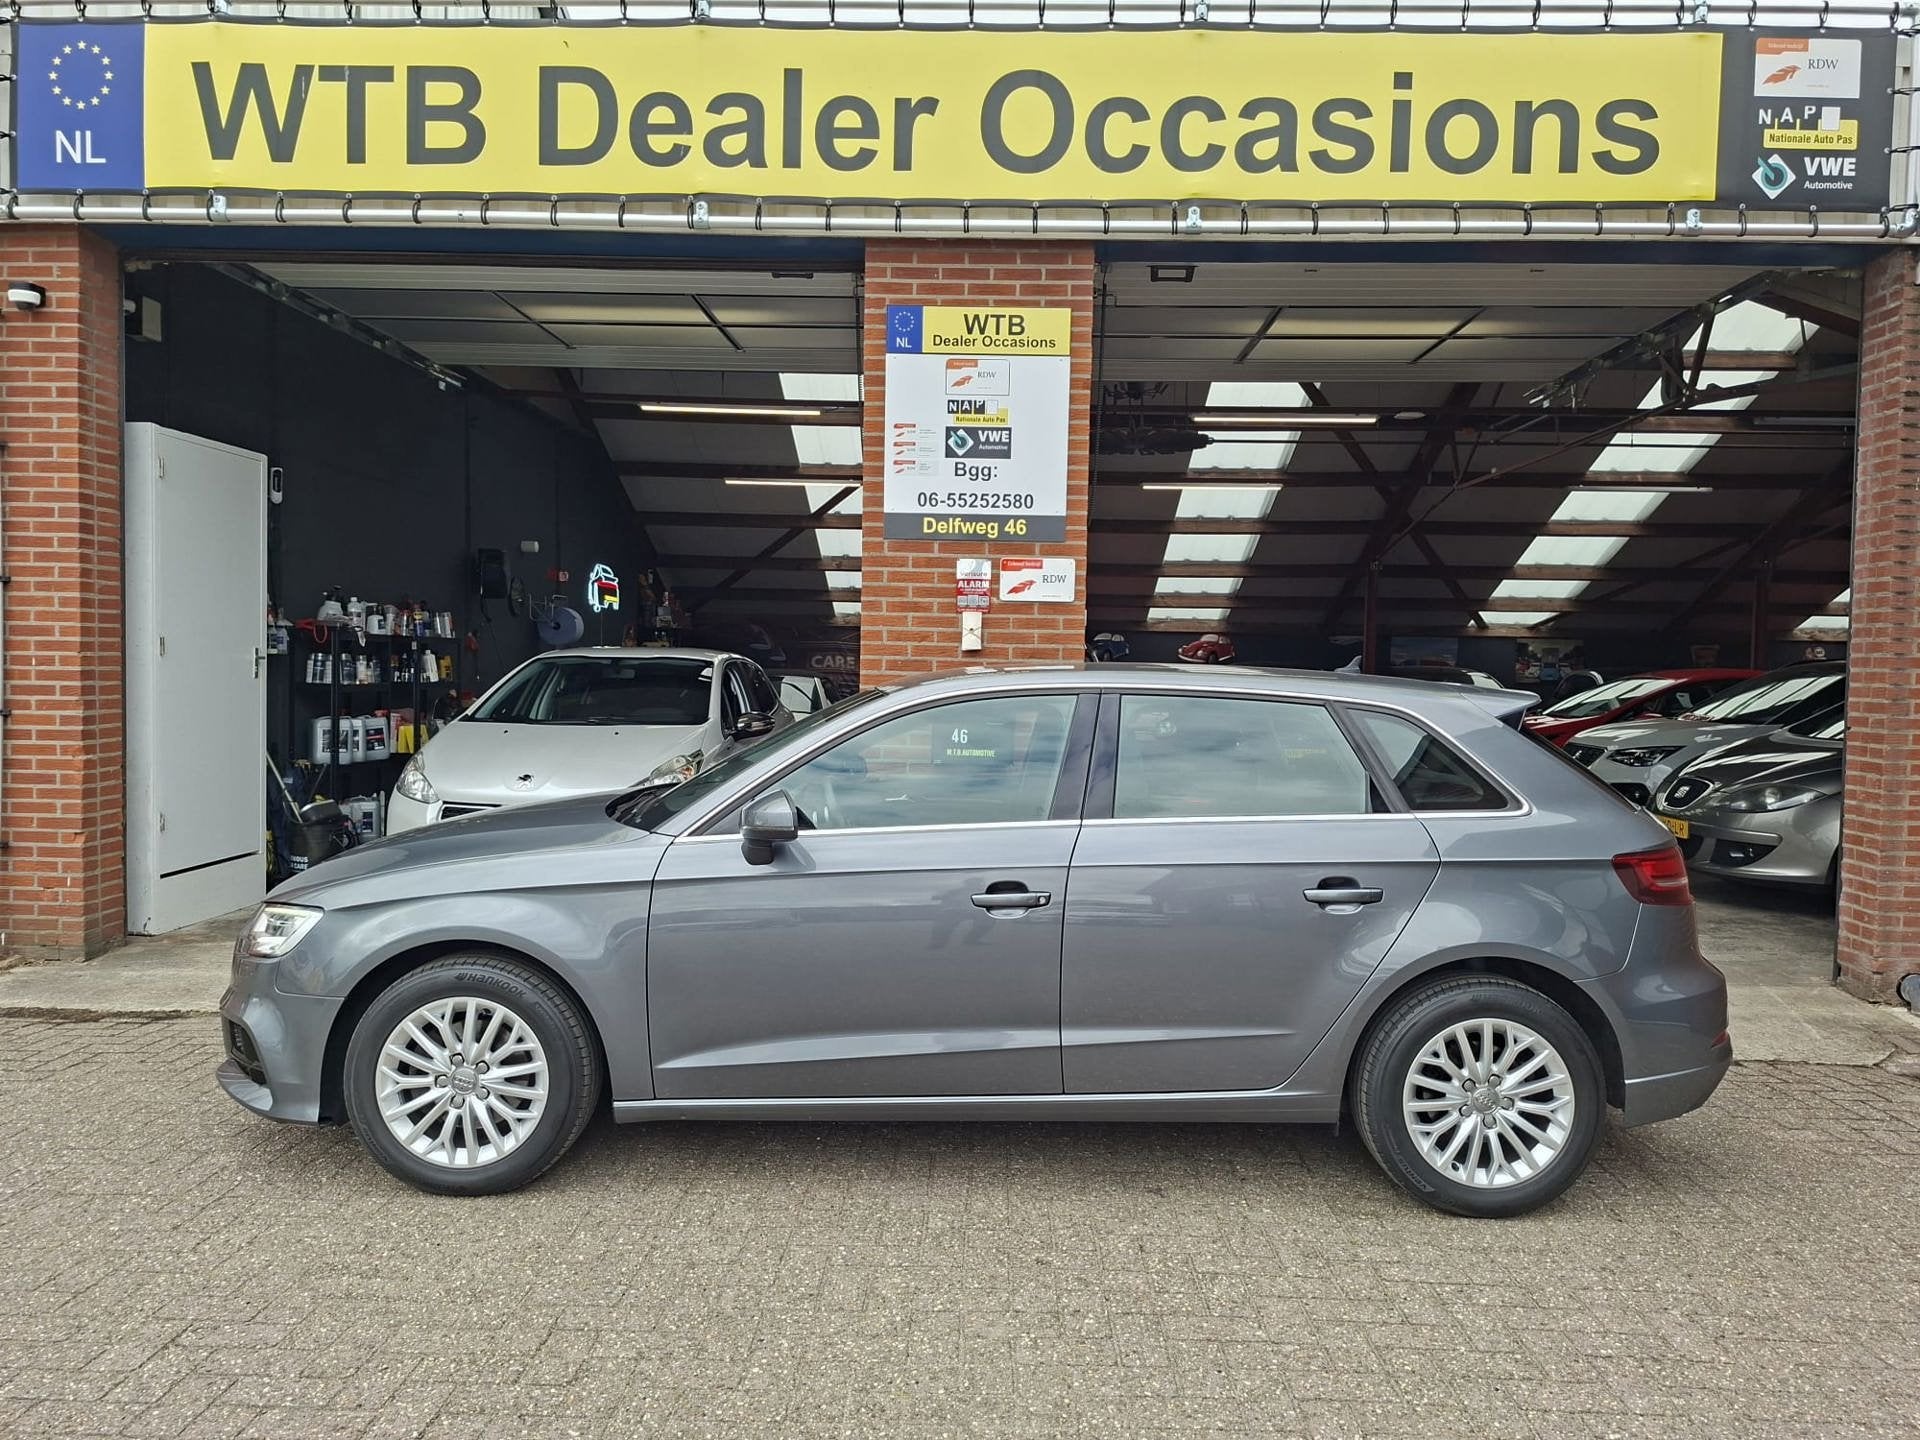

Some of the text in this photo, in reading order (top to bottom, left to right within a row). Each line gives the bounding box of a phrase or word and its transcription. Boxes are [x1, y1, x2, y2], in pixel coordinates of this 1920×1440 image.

[1808, 59, 1839, 70] RDW
[191, 62, 1660, 175] WTB Dealer Occasions
[1769, 134, 1853, 144] Nationale Auto Pas
[54, 130, 107, 164] NL
[1804, 157, 1856, 176] VWE
[1804, 181, 1853, 189] Automotive
[964, 314, 1025, 335] WTB
[896, 338, 912, 348] NL
[933, 335, 1056, 348] Dealer Occasions
[978, 430, 1010, 442] VWE
[954, 462, 998, 481] Bgg:
[917, 492, 1034, 509] 06-55252580
[923, 517, 1027, 538] Delfweg 46
[958, 581, 990, 589] ALARM
[1042, 575, 1067, 584] RDW
[811, 655, 856, 669] CARE
[951, 728, 969, 744] 46
